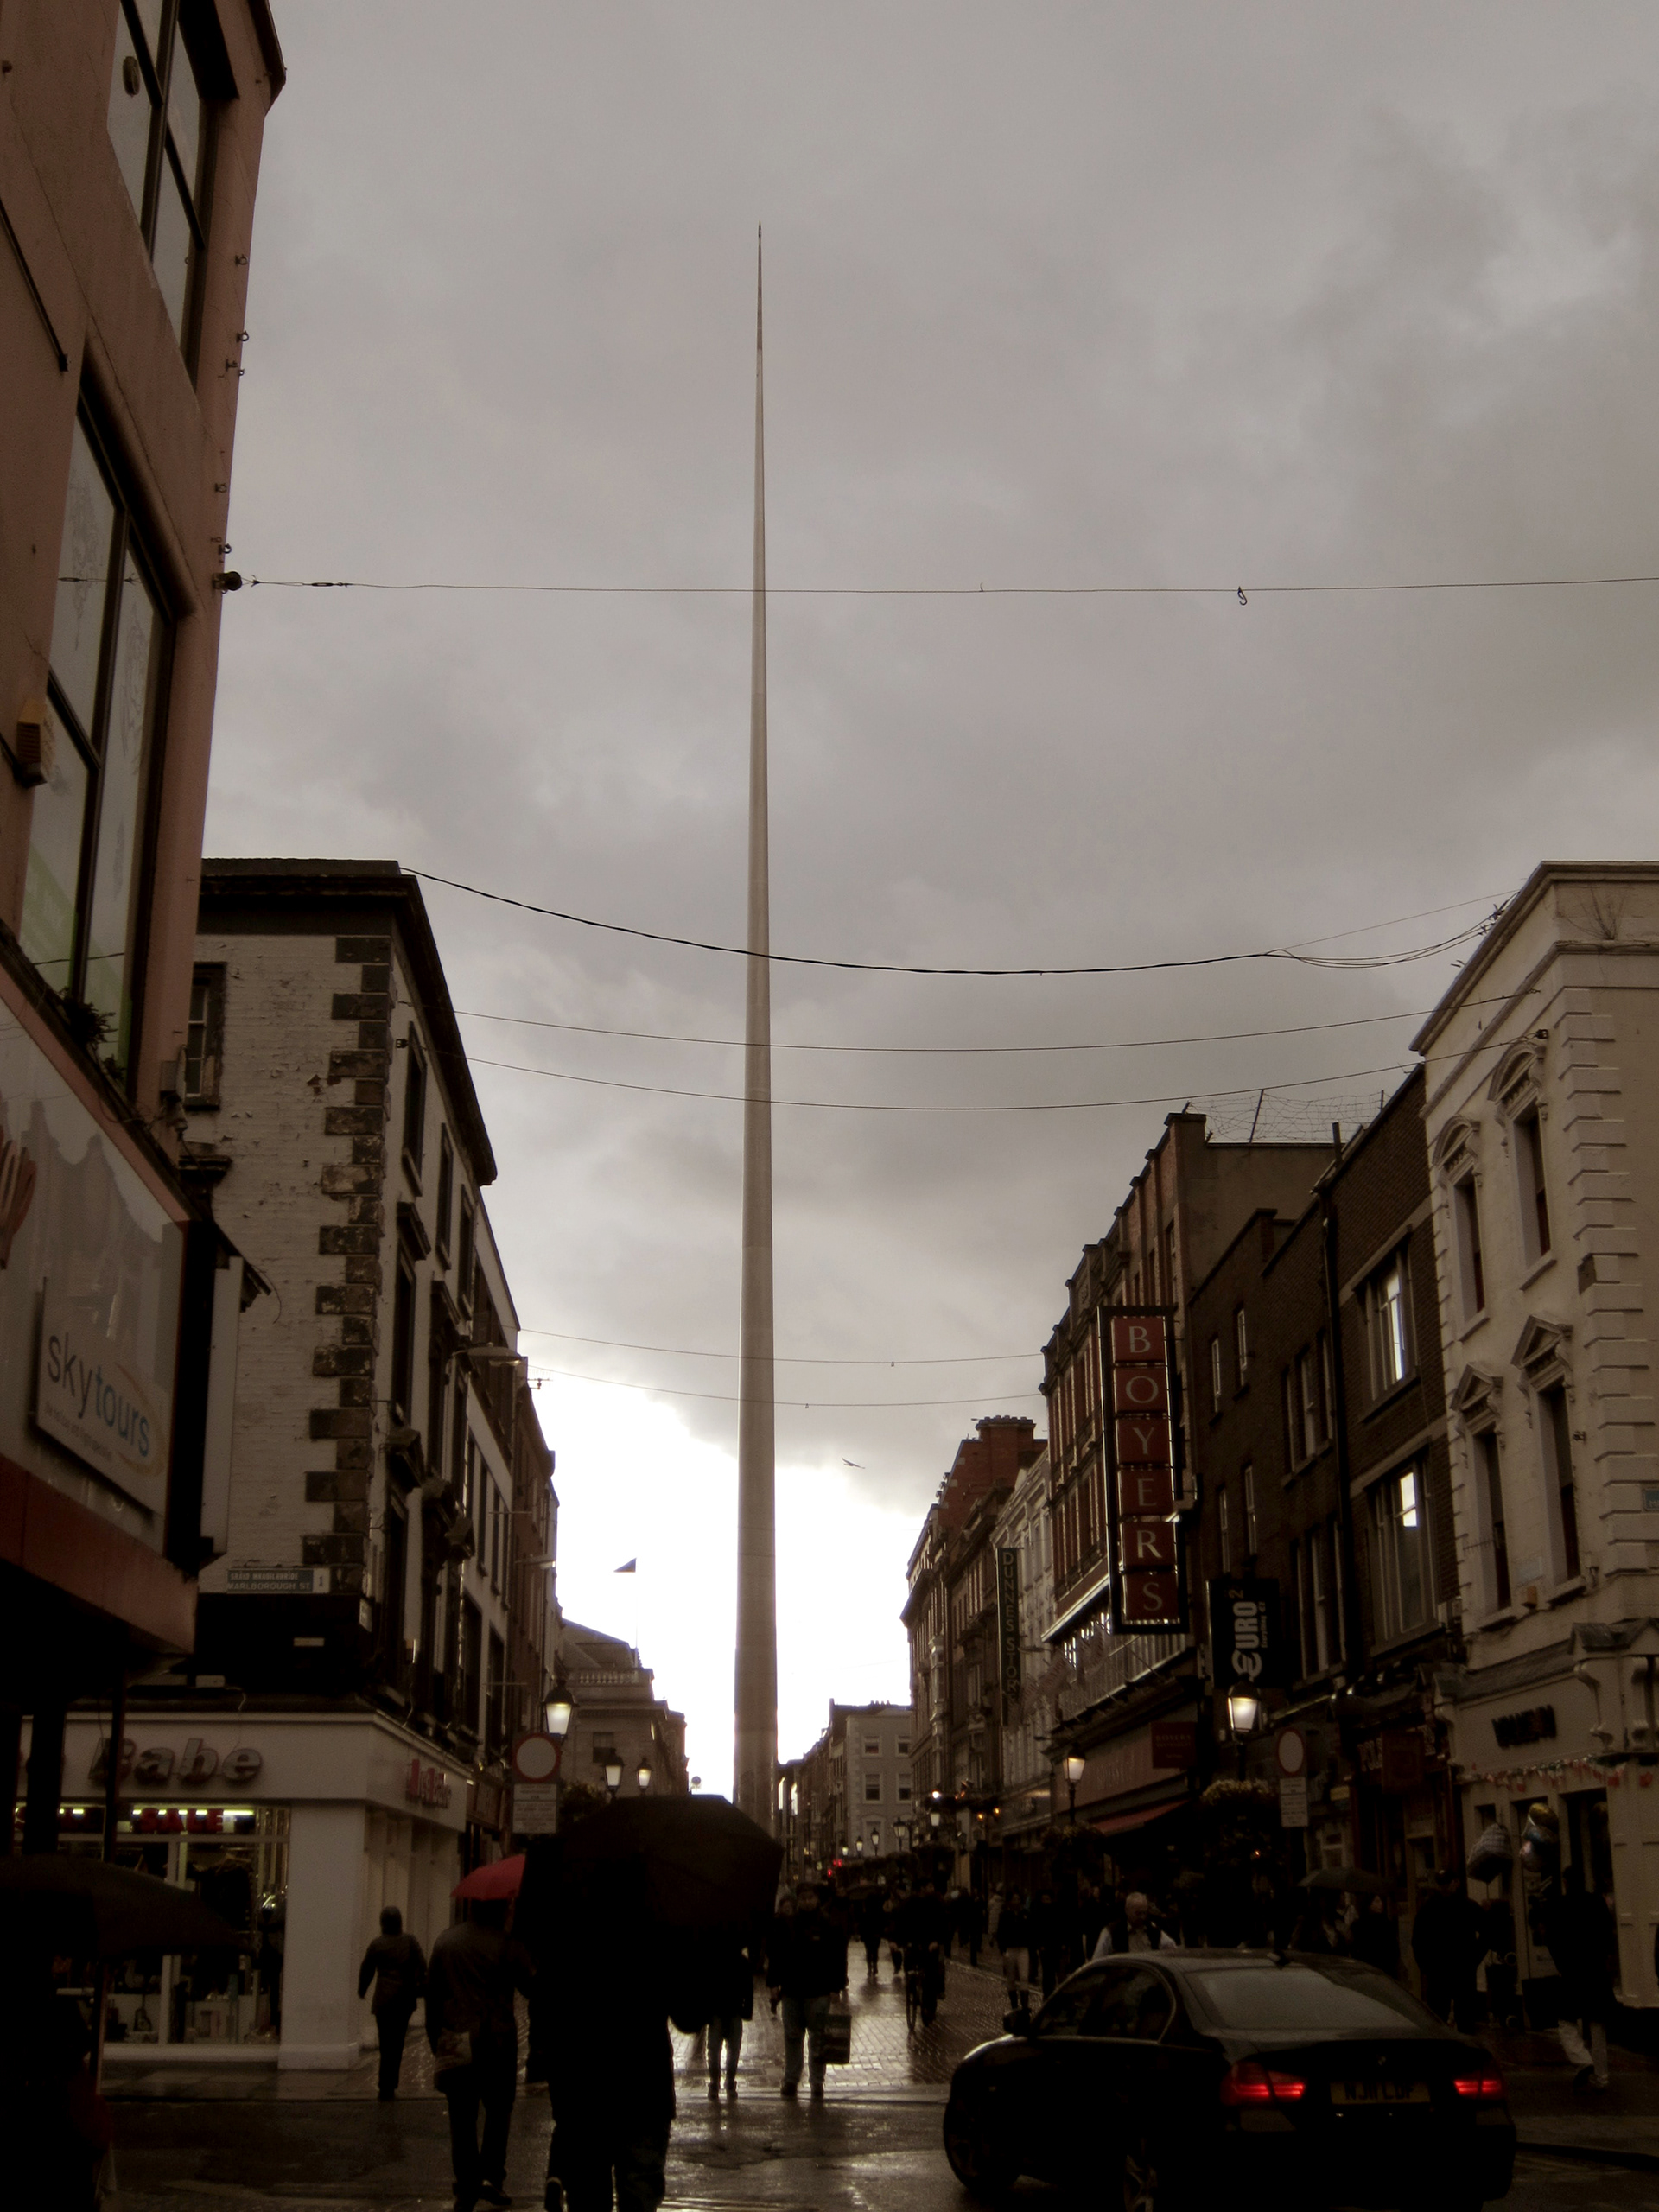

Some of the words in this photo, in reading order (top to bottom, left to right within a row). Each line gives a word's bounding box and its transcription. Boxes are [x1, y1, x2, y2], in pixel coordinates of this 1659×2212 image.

[1124, 1325, 1164, 1612] BOYERS
[227, 1582, 296, 1591] MARLBOROUGH
[1002, 1552, 1015, 1632] DUNNES
[1005, 1637, 1020, 1695] STOR
